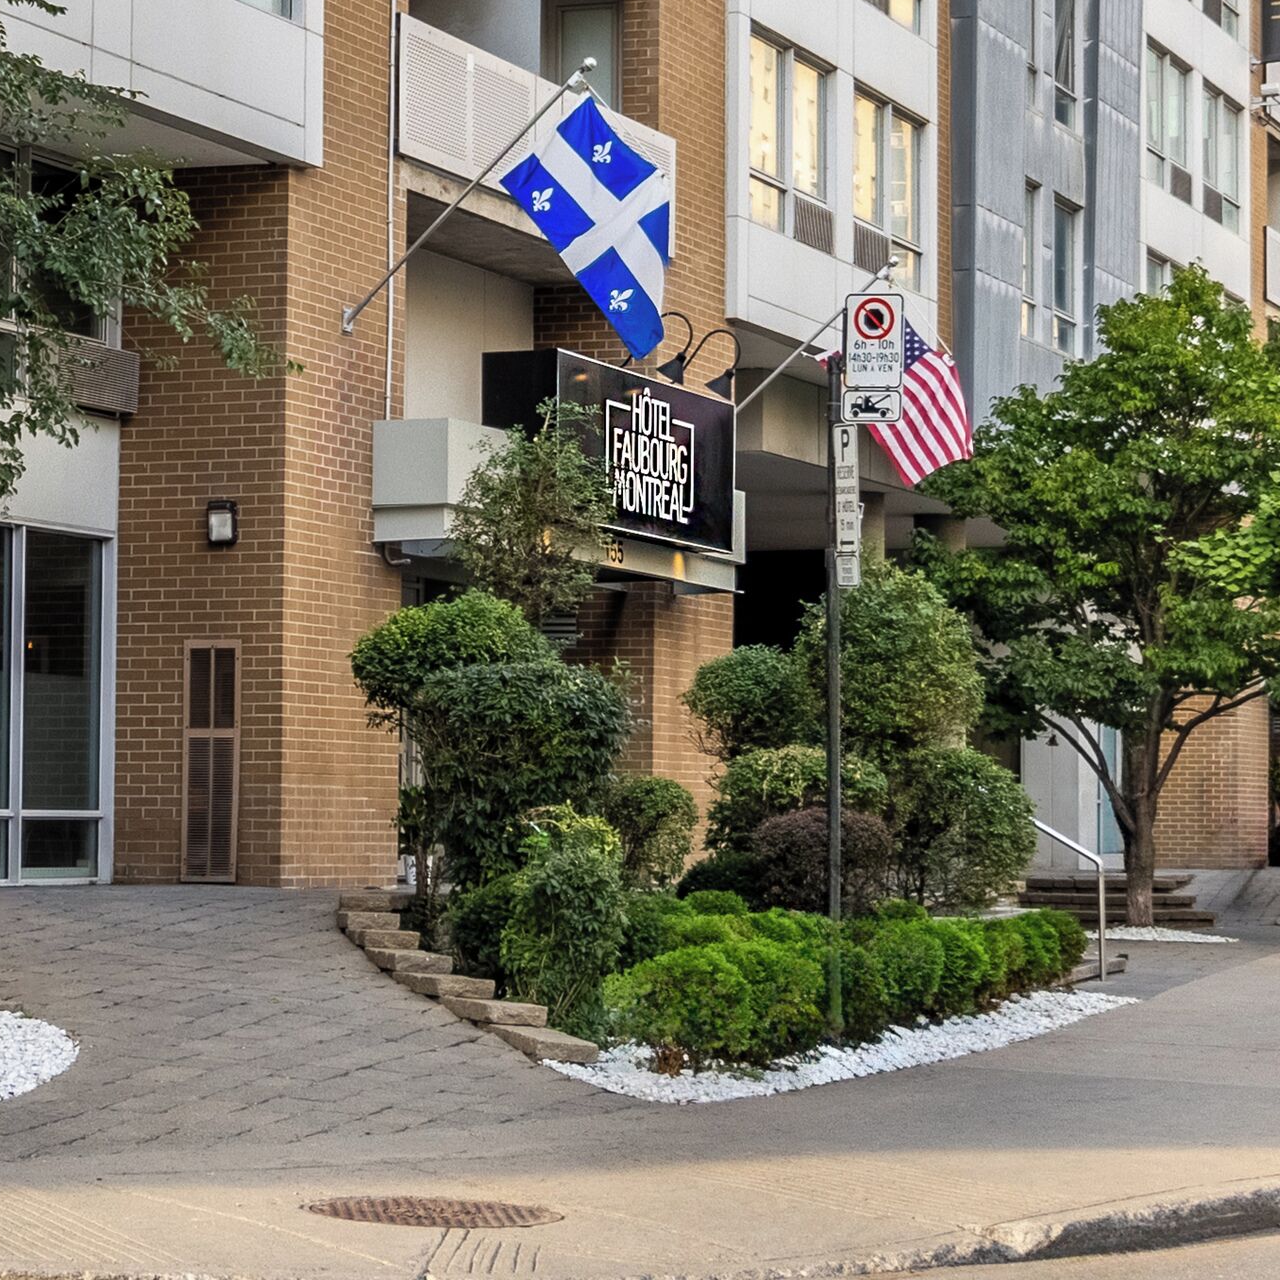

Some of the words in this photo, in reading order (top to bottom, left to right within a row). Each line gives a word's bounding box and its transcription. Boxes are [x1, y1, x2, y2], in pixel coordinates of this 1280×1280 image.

[854, 339, 867, 350] 6h
[878, 339, 894, 350] 10h
[848, 352, 899, 363] 14h30-19h30
[852, 363, 867, 373] LUN
[878, 363, 893, 373] VEN
[632, 387, 676, 443] HÔTEL
[613, 427, 688, 485] FAUBOURG
[841, 428, 850, 462] P
